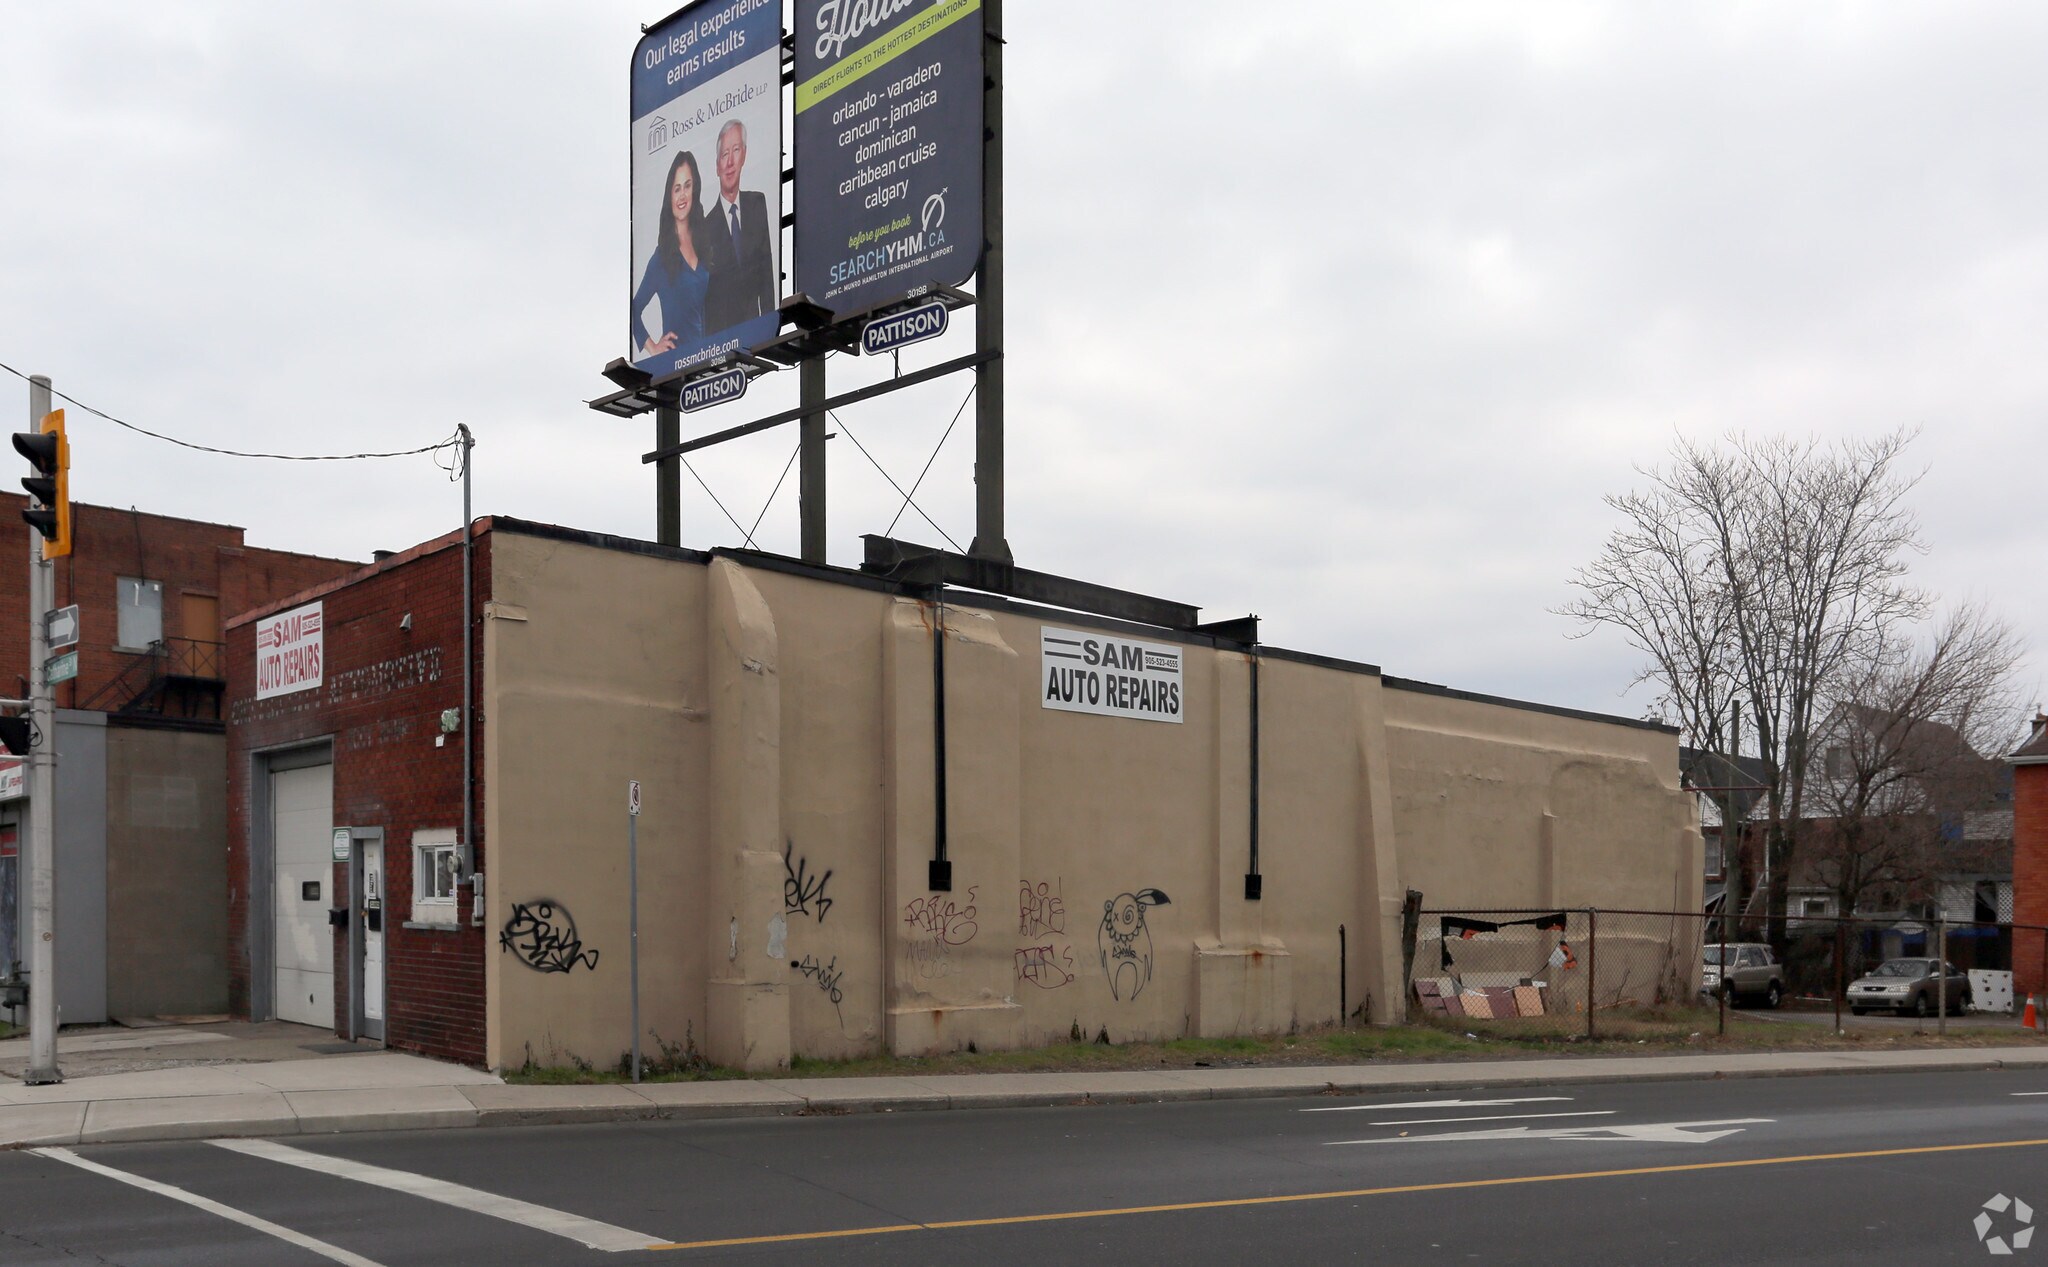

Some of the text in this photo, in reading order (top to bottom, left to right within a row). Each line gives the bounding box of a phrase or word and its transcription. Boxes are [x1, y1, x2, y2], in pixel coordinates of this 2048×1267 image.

[645, 45, 667, 70] Our
[669, 21, 698, 55] legal
[667, 30, 745, 85] earns results
[813, 76, 836, 94] DIRECT
[836, 60, 863, 79] FLIGHTS
[863, 55, 872, 65] TO
[873, 47, 886, 59] THE
[887, 27, 916, 50] HOTTEST
[671, 82, 768, 139] Ross & McBride LLP
[832, 92, 876, 125] orlando
[887, 61, 941, 99] varadero
[838, 117, 880, 147] cancun
[889, 90, 938, 128] jamaica
[839, 141, 937, 196] caribbean cruise
[855, 125, 916, 164] dominican
[865, 179, 909, 209] calgary
[848, 214, 912, 250] before you book
[825, 245, 953, 300] JOHN C. MUNRO HAMILTON INTERNATIONAL AIRPORT
[907, 285, 928, 299] 3019B
[868, 309, 940, 348] PATTISON
[674, 337, 739, 371] rossmcbride.com
[685, 374, 741, 407] PATTISON
[273, 614, 302, 648] SAM
[1083, 639, 1143, 672] SAM
[259, 654, 281, 692] AUTO
[283, 642, 320, 686] REPAIRS
[1046, 666, 1179, 715] AUTO REPAIRS
